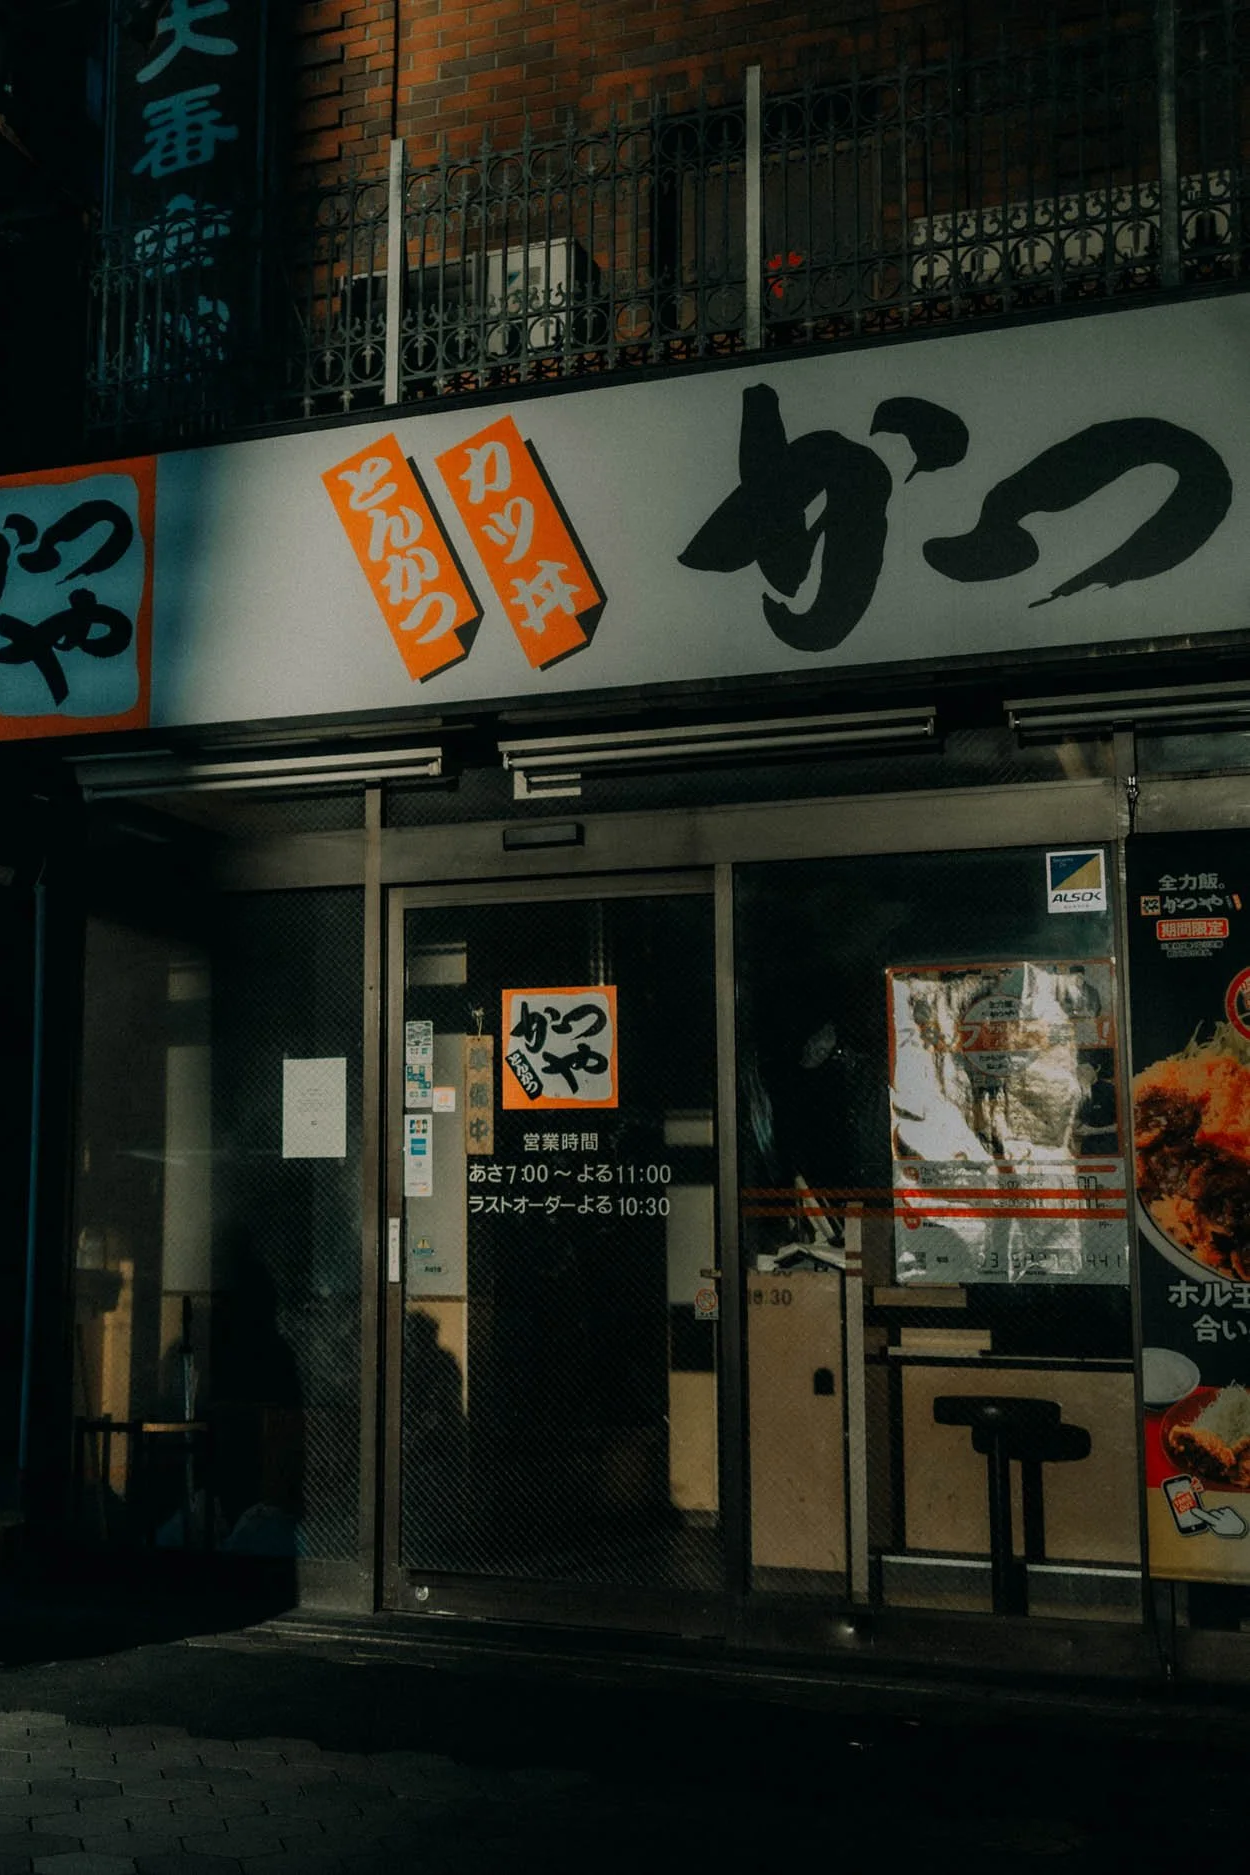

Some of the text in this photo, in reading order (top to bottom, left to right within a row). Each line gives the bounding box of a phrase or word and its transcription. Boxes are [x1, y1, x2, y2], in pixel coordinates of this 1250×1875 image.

[338, 456, 457, 644] とんかつ
[460, 441, 581, 634] カツ丼
[1052, 891, 1102, 903] ALSOK
[1160, 920, 1224, 938] 期間限定
[508, 1053, 539, 1094] とんかつ
[523, 1132, 599, 1152] 営業時間
[1192, 1313, 1250, 1343] 合い
